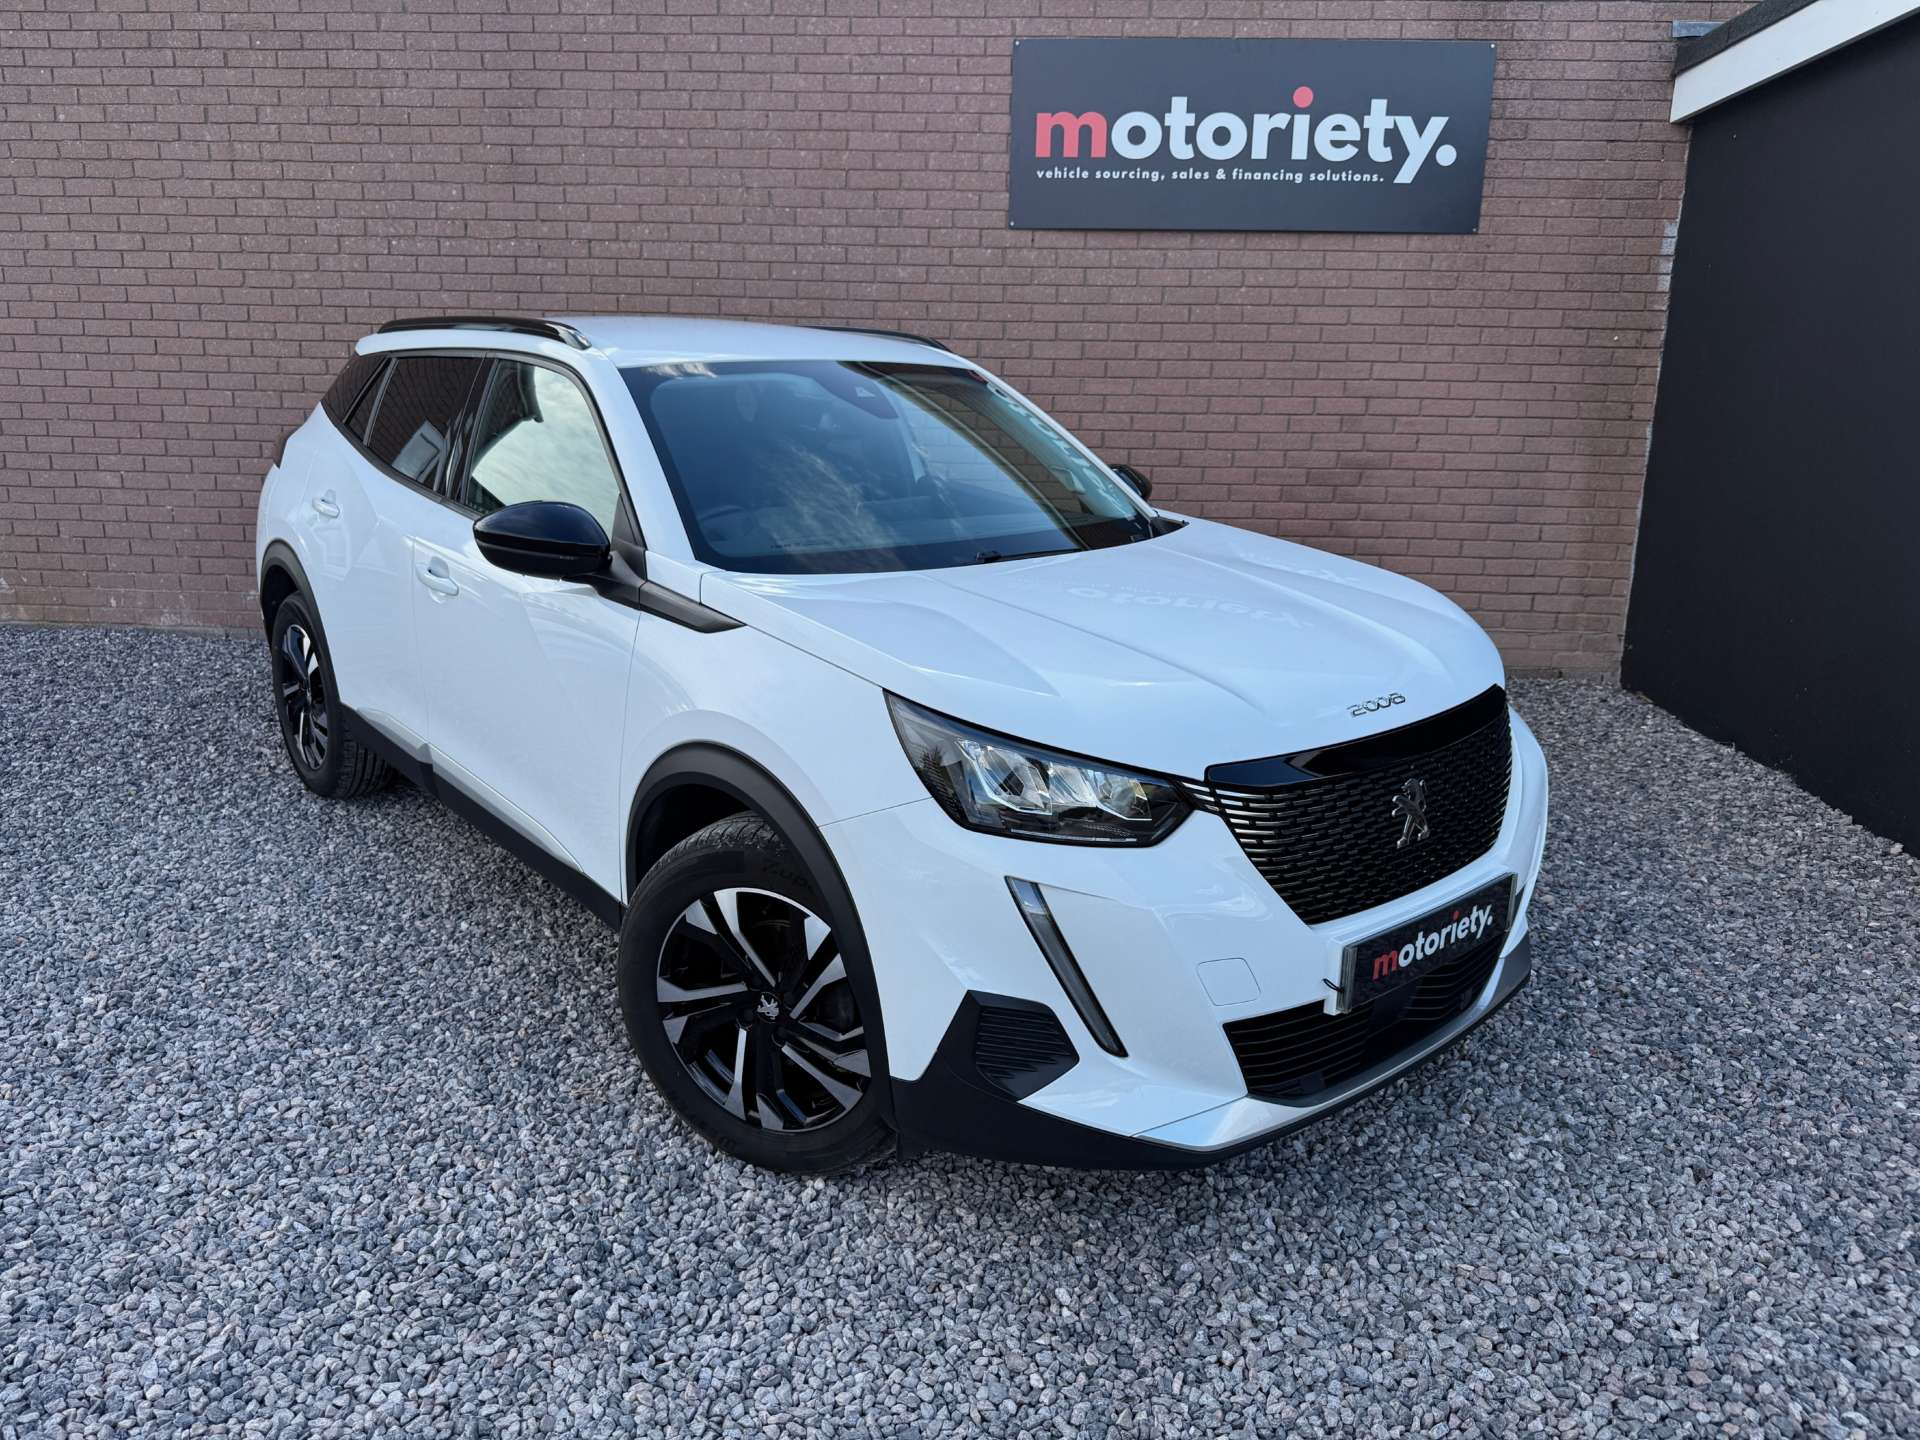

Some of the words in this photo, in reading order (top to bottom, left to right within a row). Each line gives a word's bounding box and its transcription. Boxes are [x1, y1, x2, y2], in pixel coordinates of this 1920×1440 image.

[1035, 86, 1457, 184] motoriety.
[1036, 166, 1089, 180] vehicle
[1095, 167, 1165, 183] sourcing,
[1171, 167, 1210, 180] sales
[1215, 168, 1227, 180] &
[1232, 168, 1303, 184] financing
[1309, 169, 1385, 183] solutions.
[1346, 692, 1406, 717] 2008
[1372, 904, 1493, 982] motoriety.
